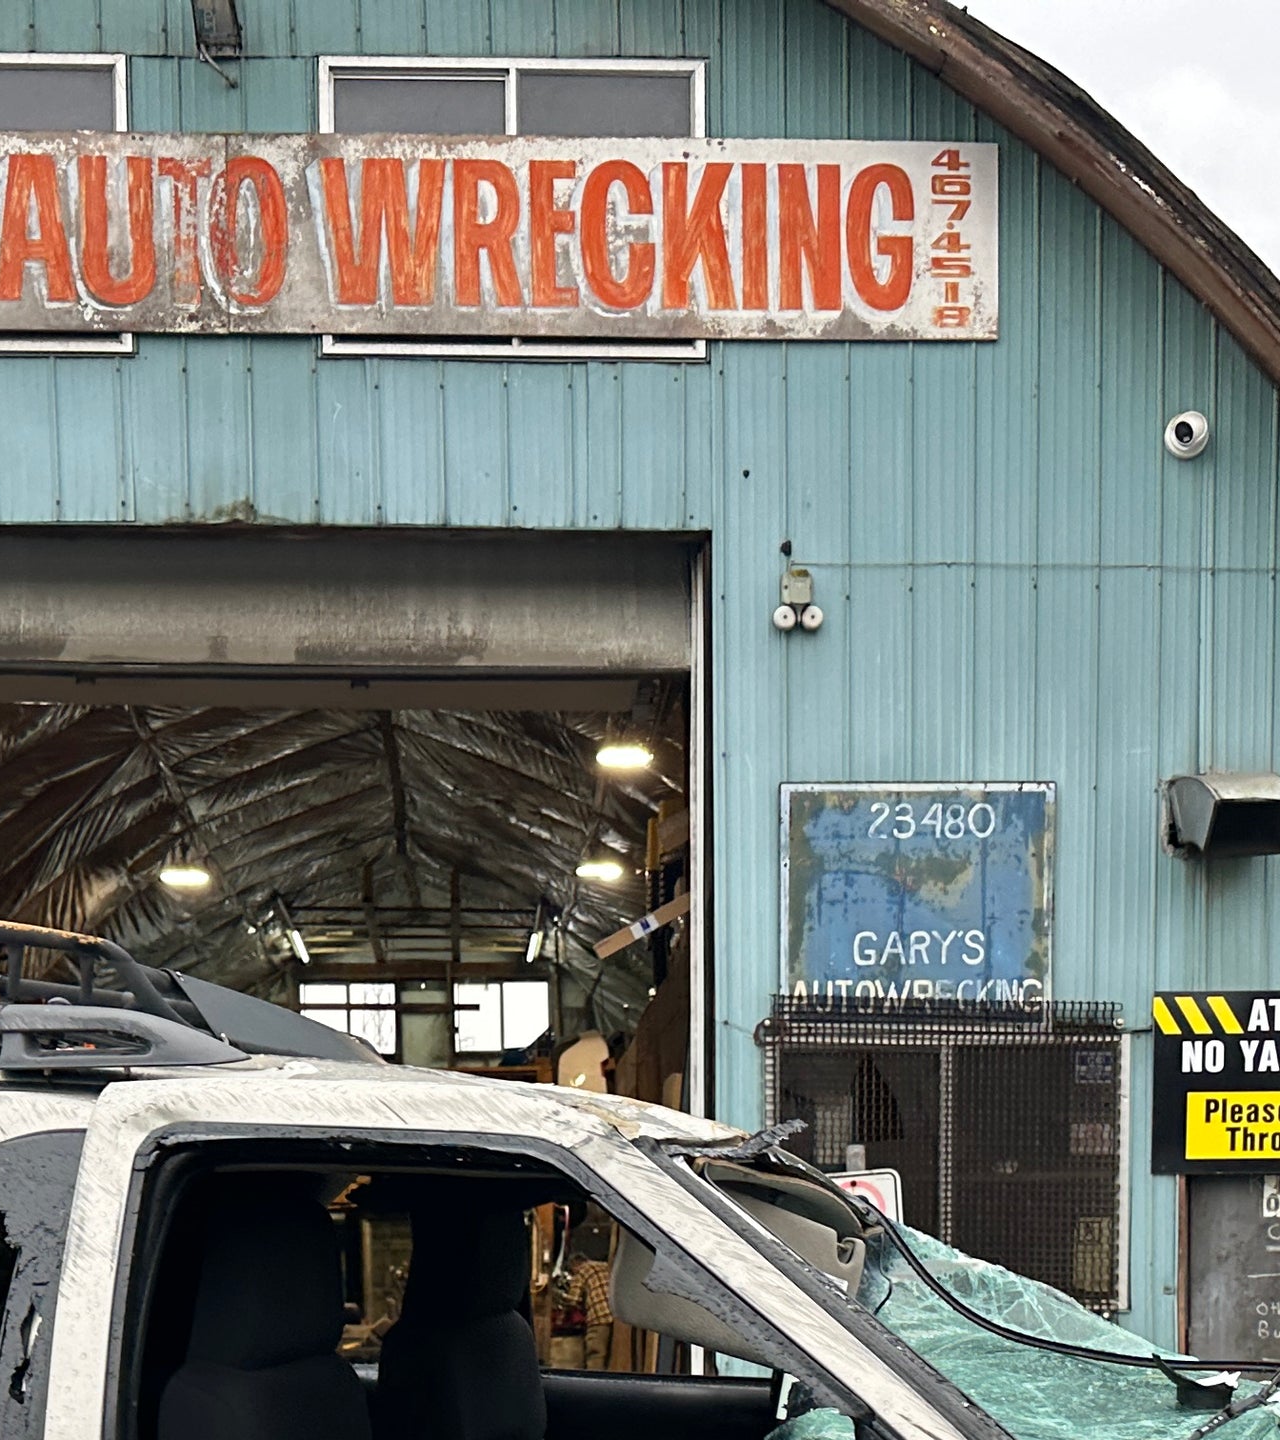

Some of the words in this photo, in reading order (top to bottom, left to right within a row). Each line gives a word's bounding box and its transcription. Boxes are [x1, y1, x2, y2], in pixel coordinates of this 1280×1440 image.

[318, 156, 915, 312] WRECKING
[867, 802, 995, 839] 23480
[853, 929, 986, 966] GARY'S
[1181, 1040, 1225, 1073] NO
